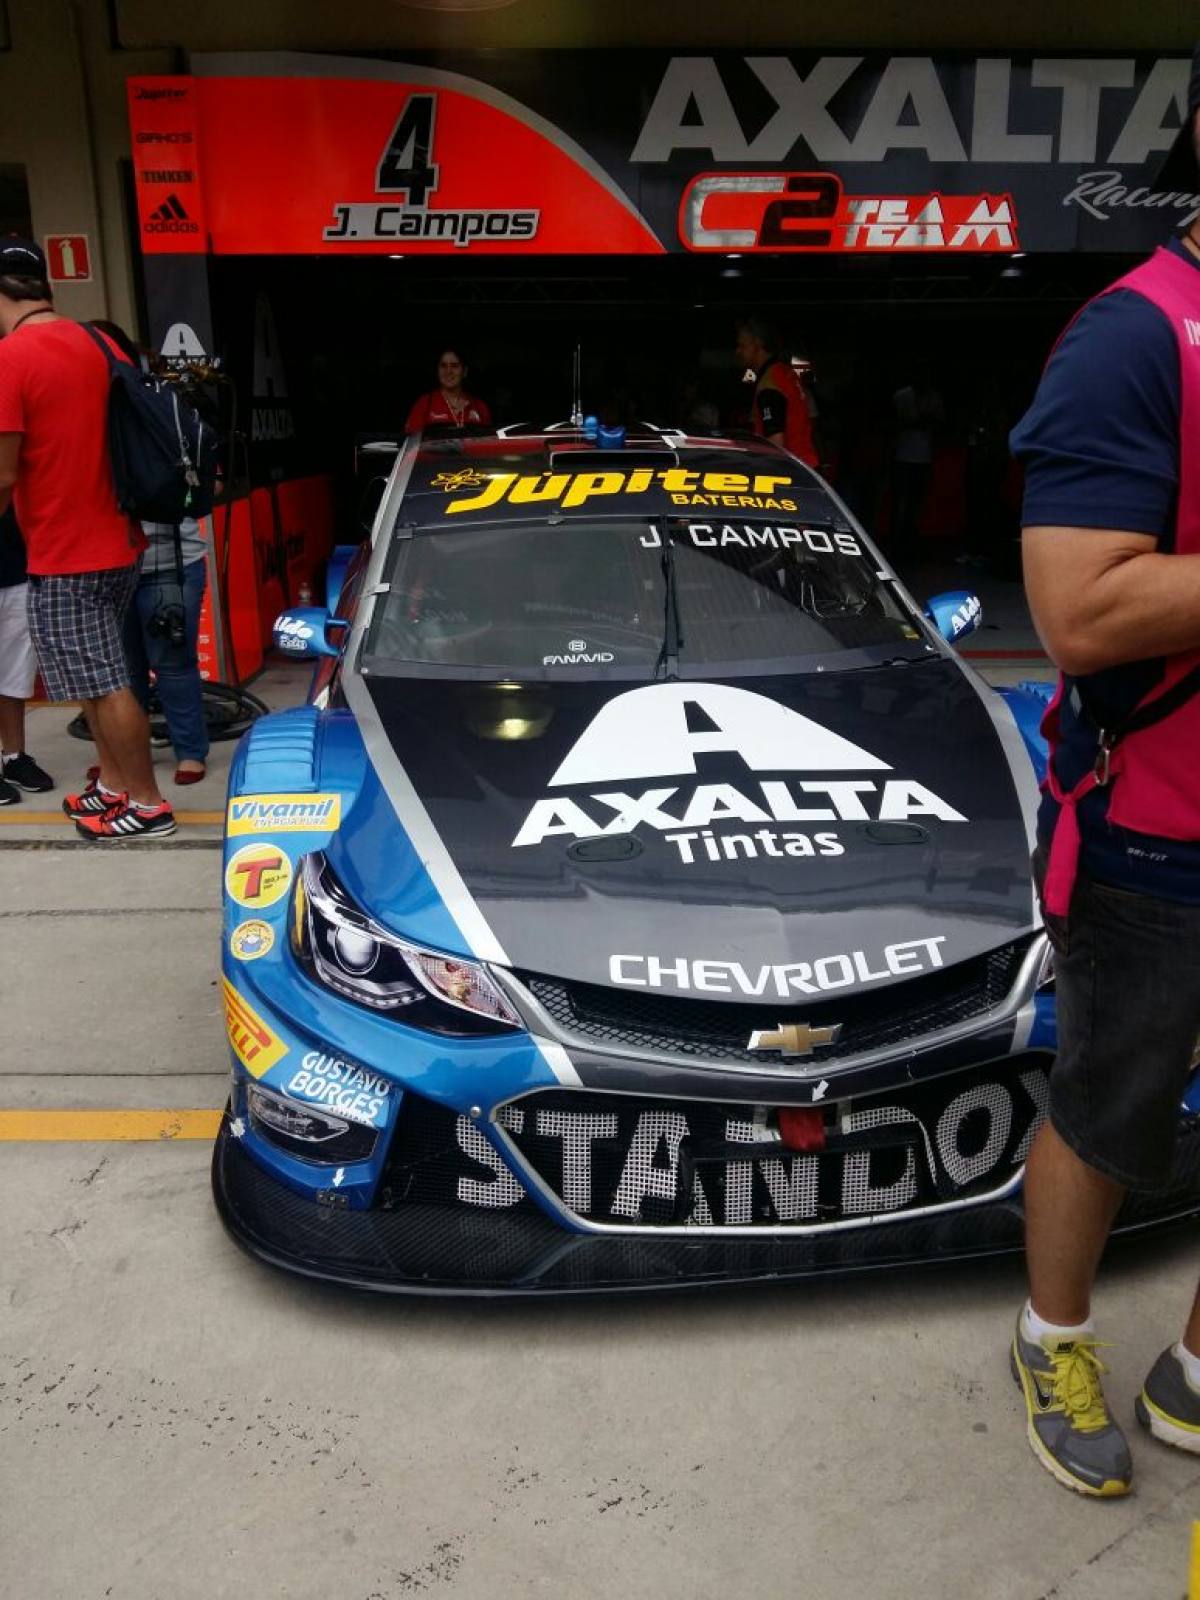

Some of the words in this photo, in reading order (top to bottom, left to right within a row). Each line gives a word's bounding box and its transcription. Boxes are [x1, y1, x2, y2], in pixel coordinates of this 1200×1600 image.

[629, 56, 1194, 163] AXALTA
[376, 94, 438, 207] 4
[143, 170, 192, 184] TIMKEN
[144, 221, 199, 233] adidas
[326, 208, 357, 237] J.
[374, 207, 536, 243] Campos
[842, 196, 1016, 247] TEAM
[671, 492, 798, 512] BATERIAS
[691, 524, 862, 556] CAMPOS
[543, 652, 615, 666] FANAVID
[231, 799, 334, 820] Vivamil
[510, 780, 970, 848] AXALTA
[664, 829, 845, 864] Tintas
[608, 935, 947, 998] CHEVROLET
[301, 1051, 390, 1097] GUSTAVO
[288, 1070, 384, 1121] BORGES
